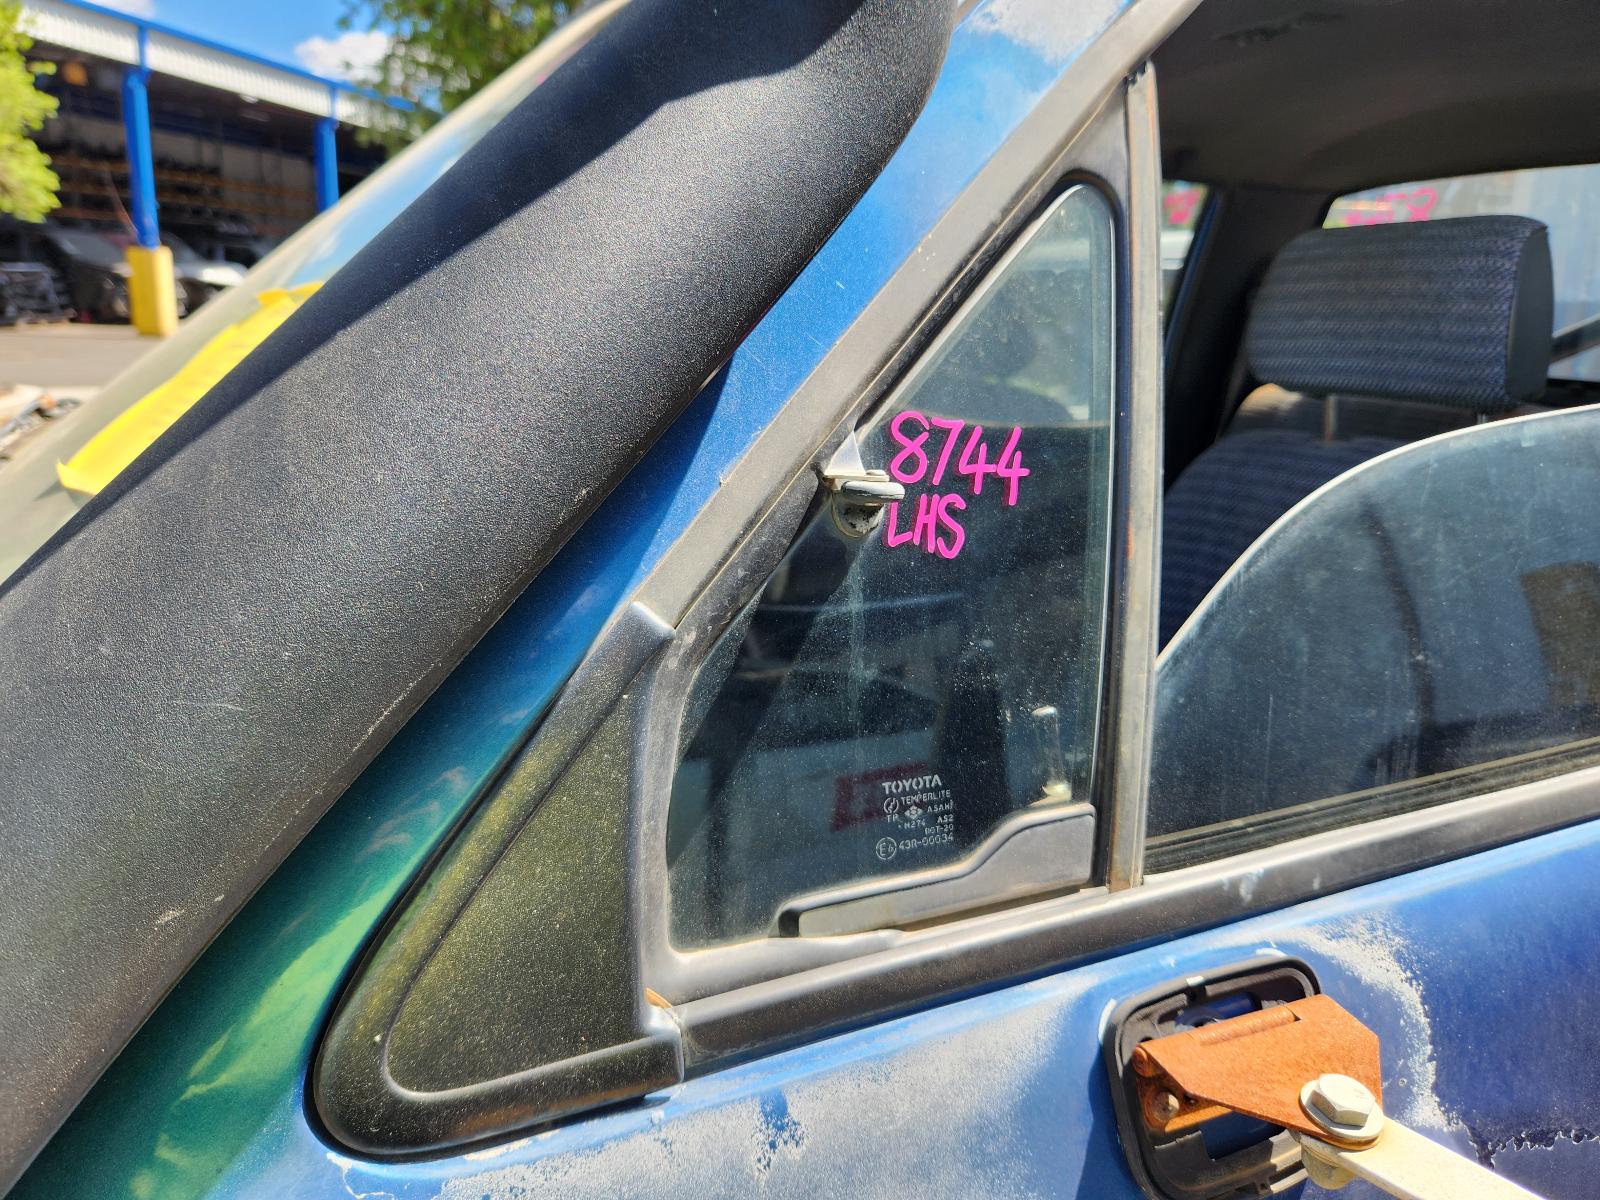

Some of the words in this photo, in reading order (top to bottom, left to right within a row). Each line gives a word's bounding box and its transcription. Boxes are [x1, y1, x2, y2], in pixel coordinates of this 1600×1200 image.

[890, 410, 1031, 506] 8744
[887, 493, 967, 559] LHS
[882, 774, 942, 795] TOYOTA
[900, 789, 951, 805] TEMPERLITE
[927, 799, 954, 813] ASAHI
[937, 814, 954, 824] AS2
